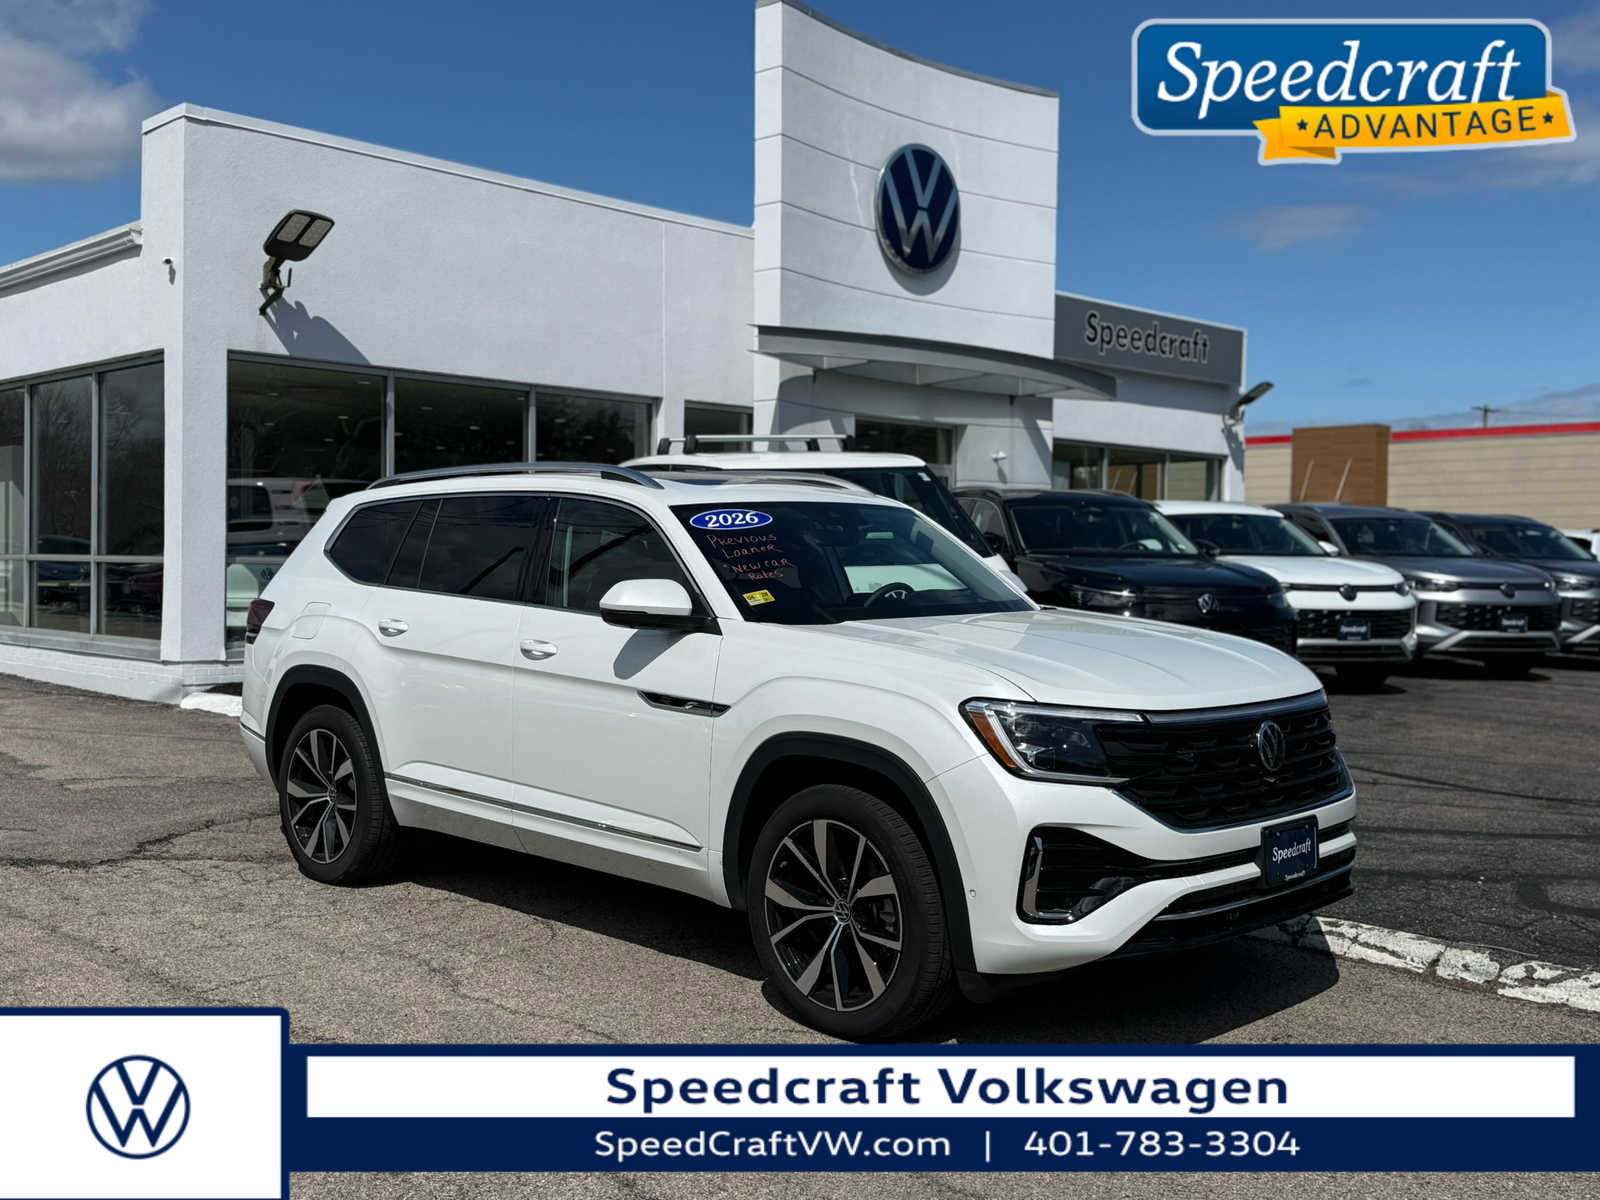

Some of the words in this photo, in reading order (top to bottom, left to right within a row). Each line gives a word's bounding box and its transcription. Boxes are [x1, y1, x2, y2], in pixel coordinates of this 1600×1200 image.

[1085, 310, 1210, 363] Speedcraft
[705, 511, 759, 528] 2026
[1271, 837, 1312, 864] Speedcraft
